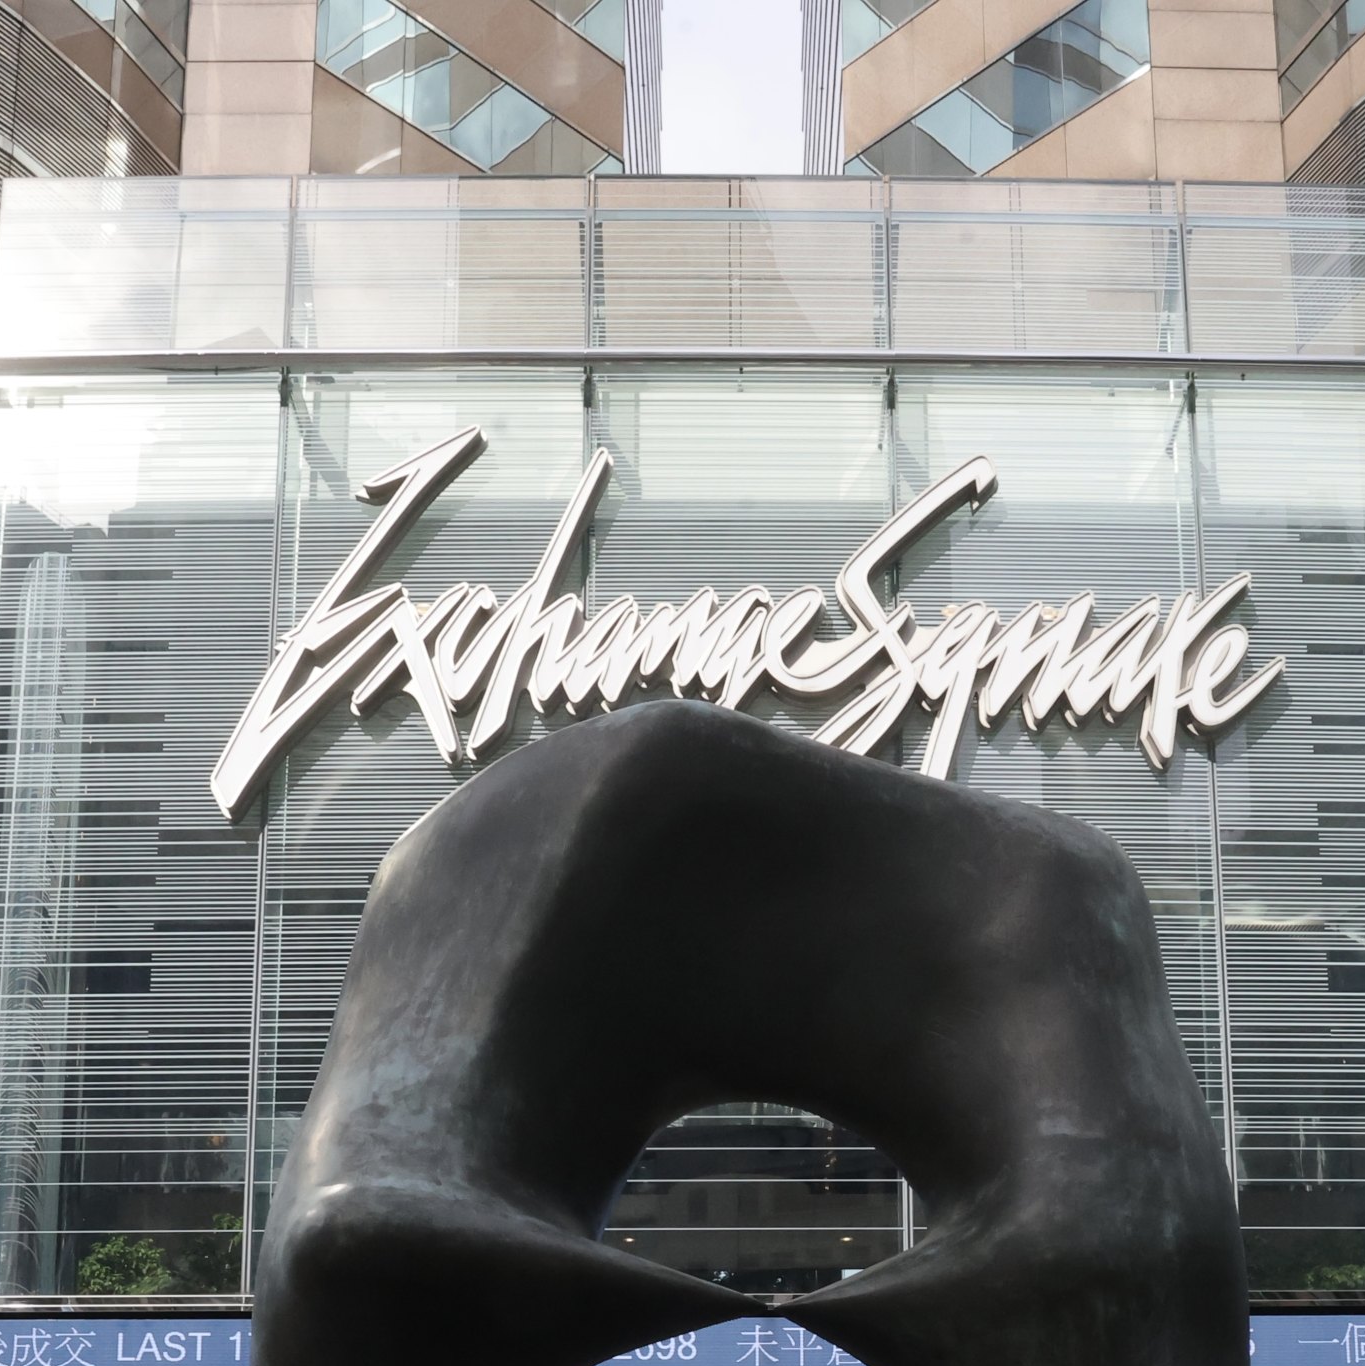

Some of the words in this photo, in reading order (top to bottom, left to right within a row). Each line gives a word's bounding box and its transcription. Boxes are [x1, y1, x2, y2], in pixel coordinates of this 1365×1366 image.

[210, 425, 831, 820] Exchange
[810, 455, 1286, 779] Square
[117, 1331, 211, 1362] LAST
